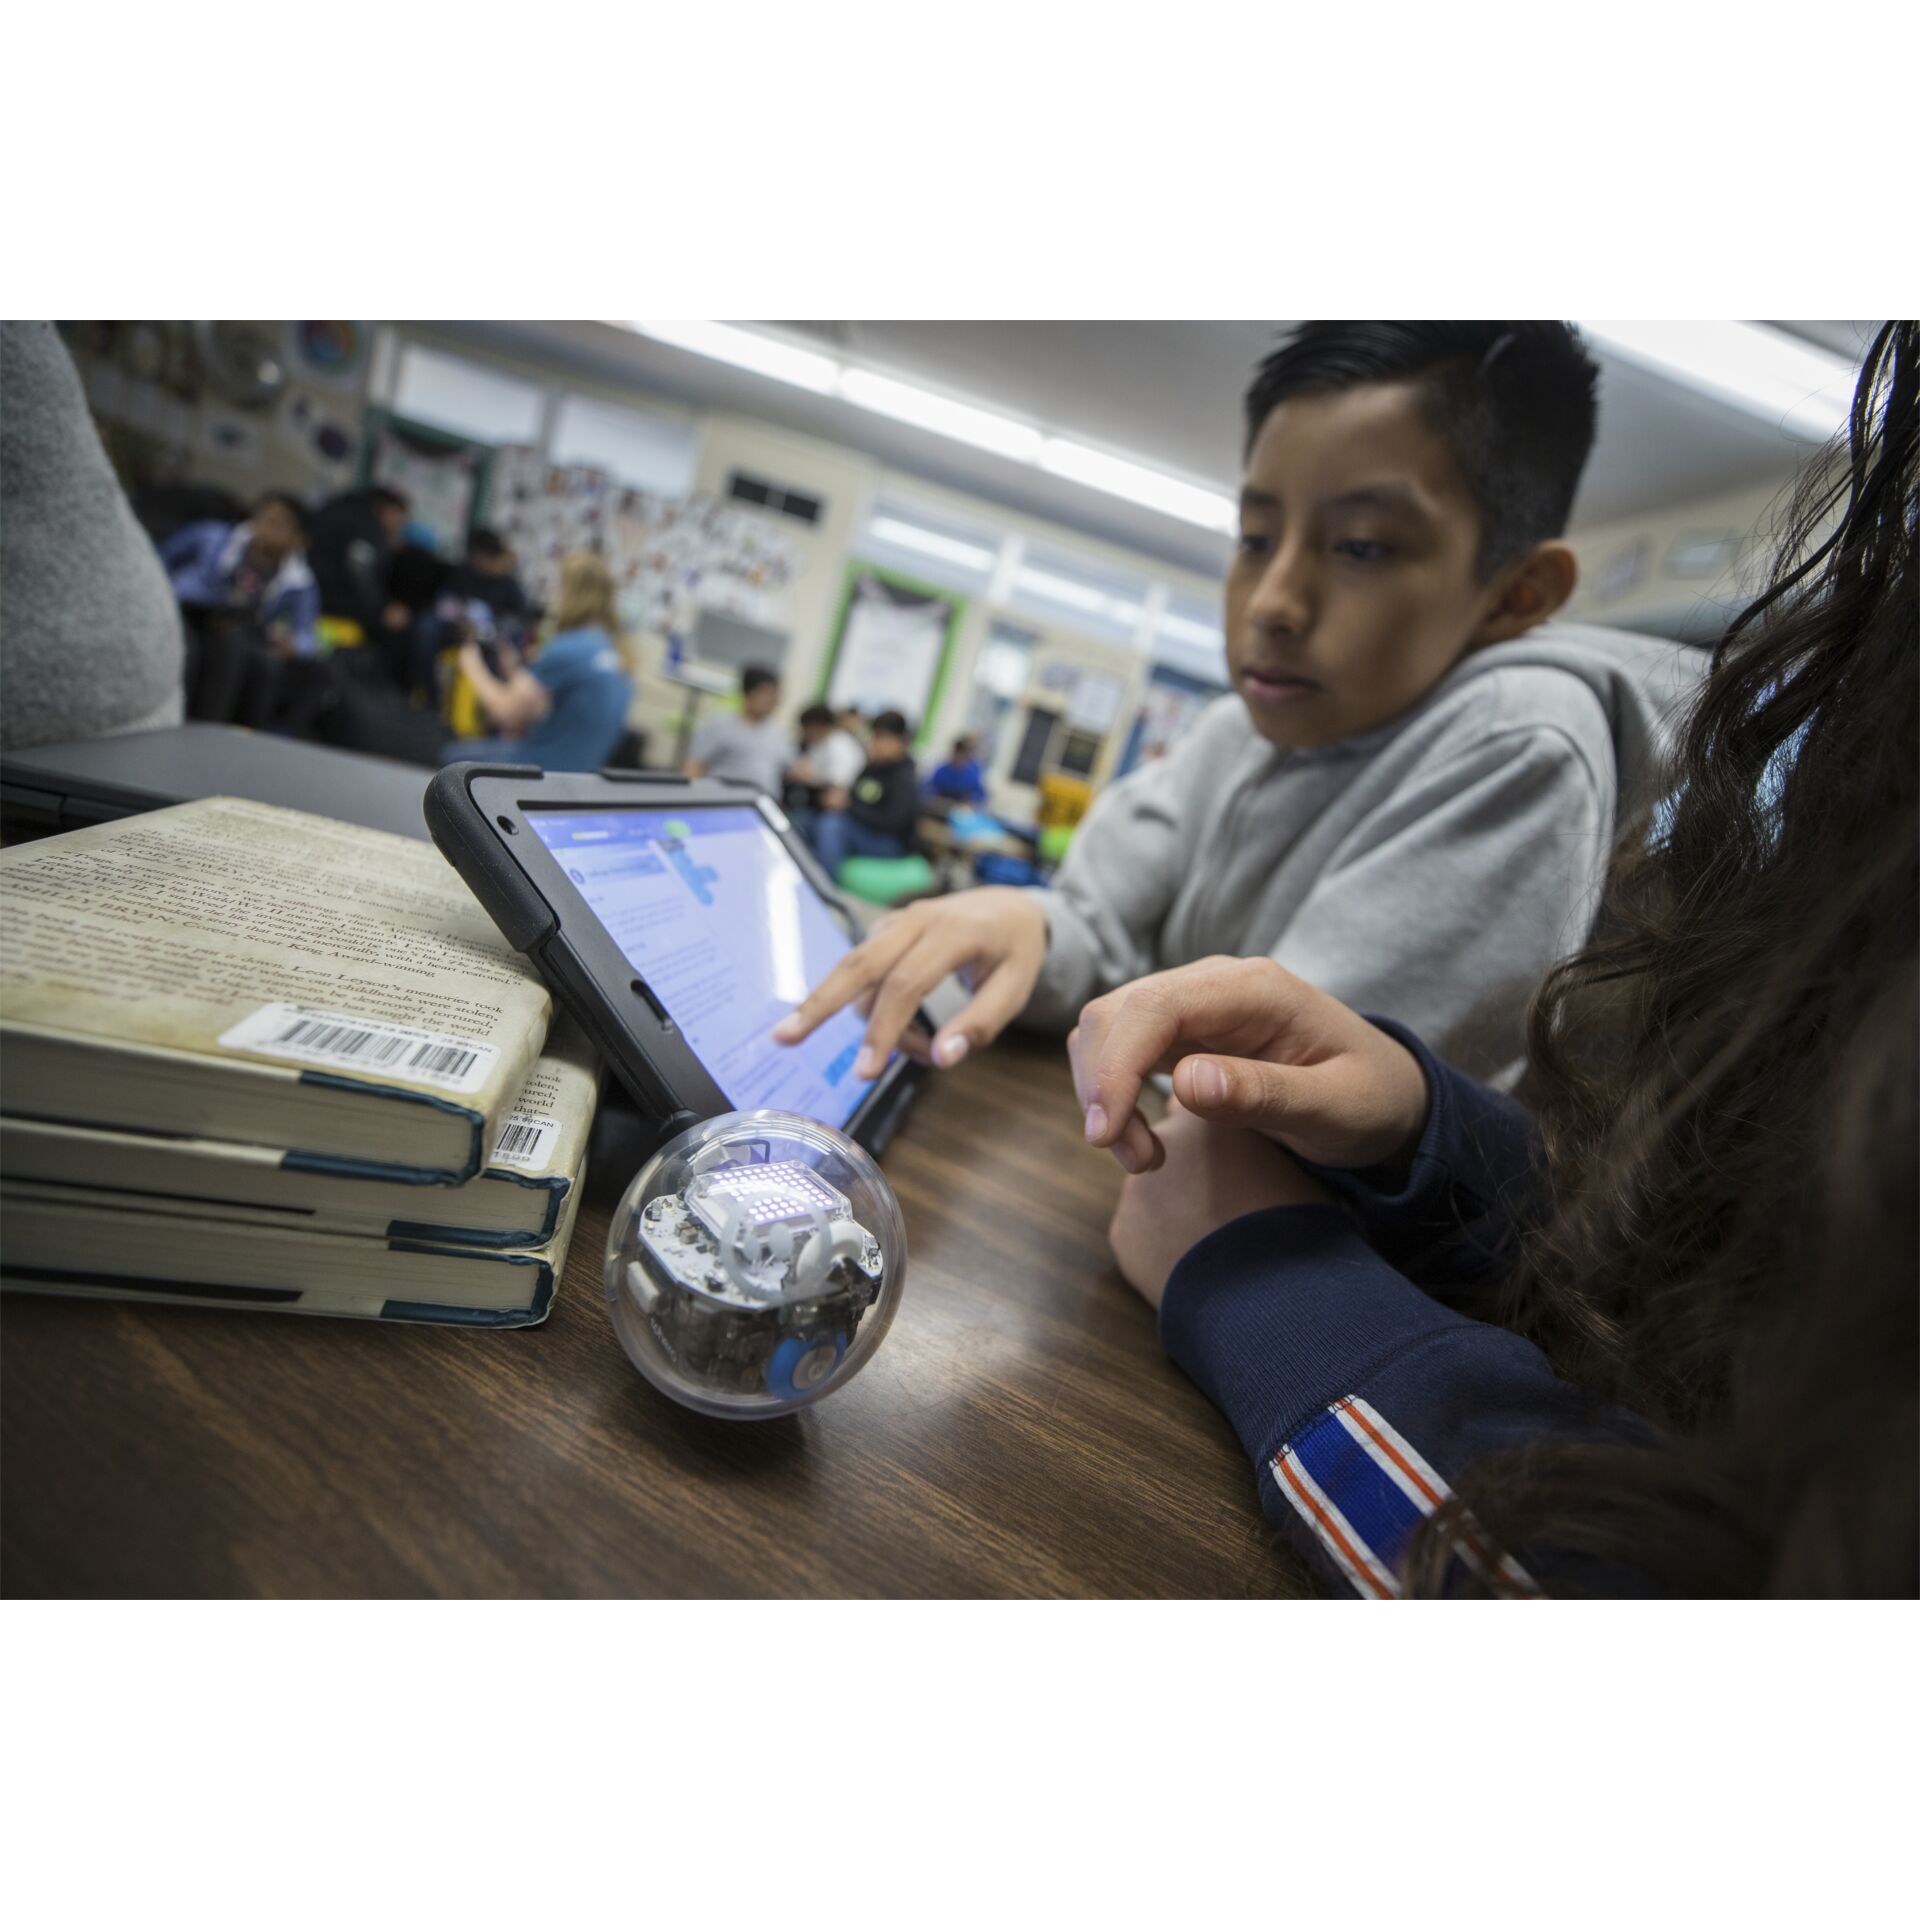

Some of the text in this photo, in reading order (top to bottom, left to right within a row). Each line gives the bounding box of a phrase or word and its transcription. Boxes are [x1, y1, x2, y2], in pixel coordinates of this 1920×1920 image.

[33, 858, 87, 872] Leyson
[89, 869, 113, 877] has
[117, 875, 166, 888] written
[192, 890, 236, 904] World
[238, 901, 266, 910] War
[40, 865, 90, 878] World
[94, 876, 127, 886] War
[168, 894, 227, 909] survived
[255, 913, 306, 927] invasion
[404, 943, 436, 954] Leon
[123, 864, 215, 886] remembrances
[345, 913, 375, 922] often
[99, 903, 176, 924] BRYAN,
[182, 921, 240, 937] Coretta
[243, 934, 284, 946] Scott
[287, 943, 324, 955] King
[107, 894, 204, 921] heartbreaking
[206, 918, 242, 928] story
[245, 926, 271, 934] that
[274, 932, 308, 942] ends,
[312, 940, 379, 956] mercifully,
[385, 954, 413, 963] with
[427, 962, 456, 971] heart
[126, 892, 159, 901] time
[163, 900, 200, 911] when
[228, 913, 249, 921] life
[267, 922, 297, 932] each
[300, 930, 327, 939] step
[329, 936, 366, 946] could
[385, 947, 418, 957] one’s
[266, 902, 298, 911] need
[317, 912, 342, 921] hear
[192, 948, 220, 956] put
[241, 957, 285, 969] down.
[291, 966, 332, 977] Leon
[335, 974, 401, 991] Leyson’s
[405, 989, 470, 1005] memories
[475, 1003, 503, 1013] took
[211, 960, 257, 972] world
[259, 969, 305, 981] where
[337, 984, 413, 1002] childhoods
[418, 999, 451, 1009] were
[455, 1007, 502, 1022] stolen,
[329, 990, 347, 998] be
[352, 995, 426, 1014] destroyed,
[430, 1011, 494, 1029] tortured,
[341, 1002, 366, 1011] has
[370, 1008, 417, 1021] taught
[422, 1018, 445, 1026] the
[450, 1023, 490, 1036] world
[518, 1098, 554, 1108] world
[523, 1089, 556, 1100] ured,
[526, 1081, 559, 1092] tolen,
[536, 1073, 561, 1083] took
